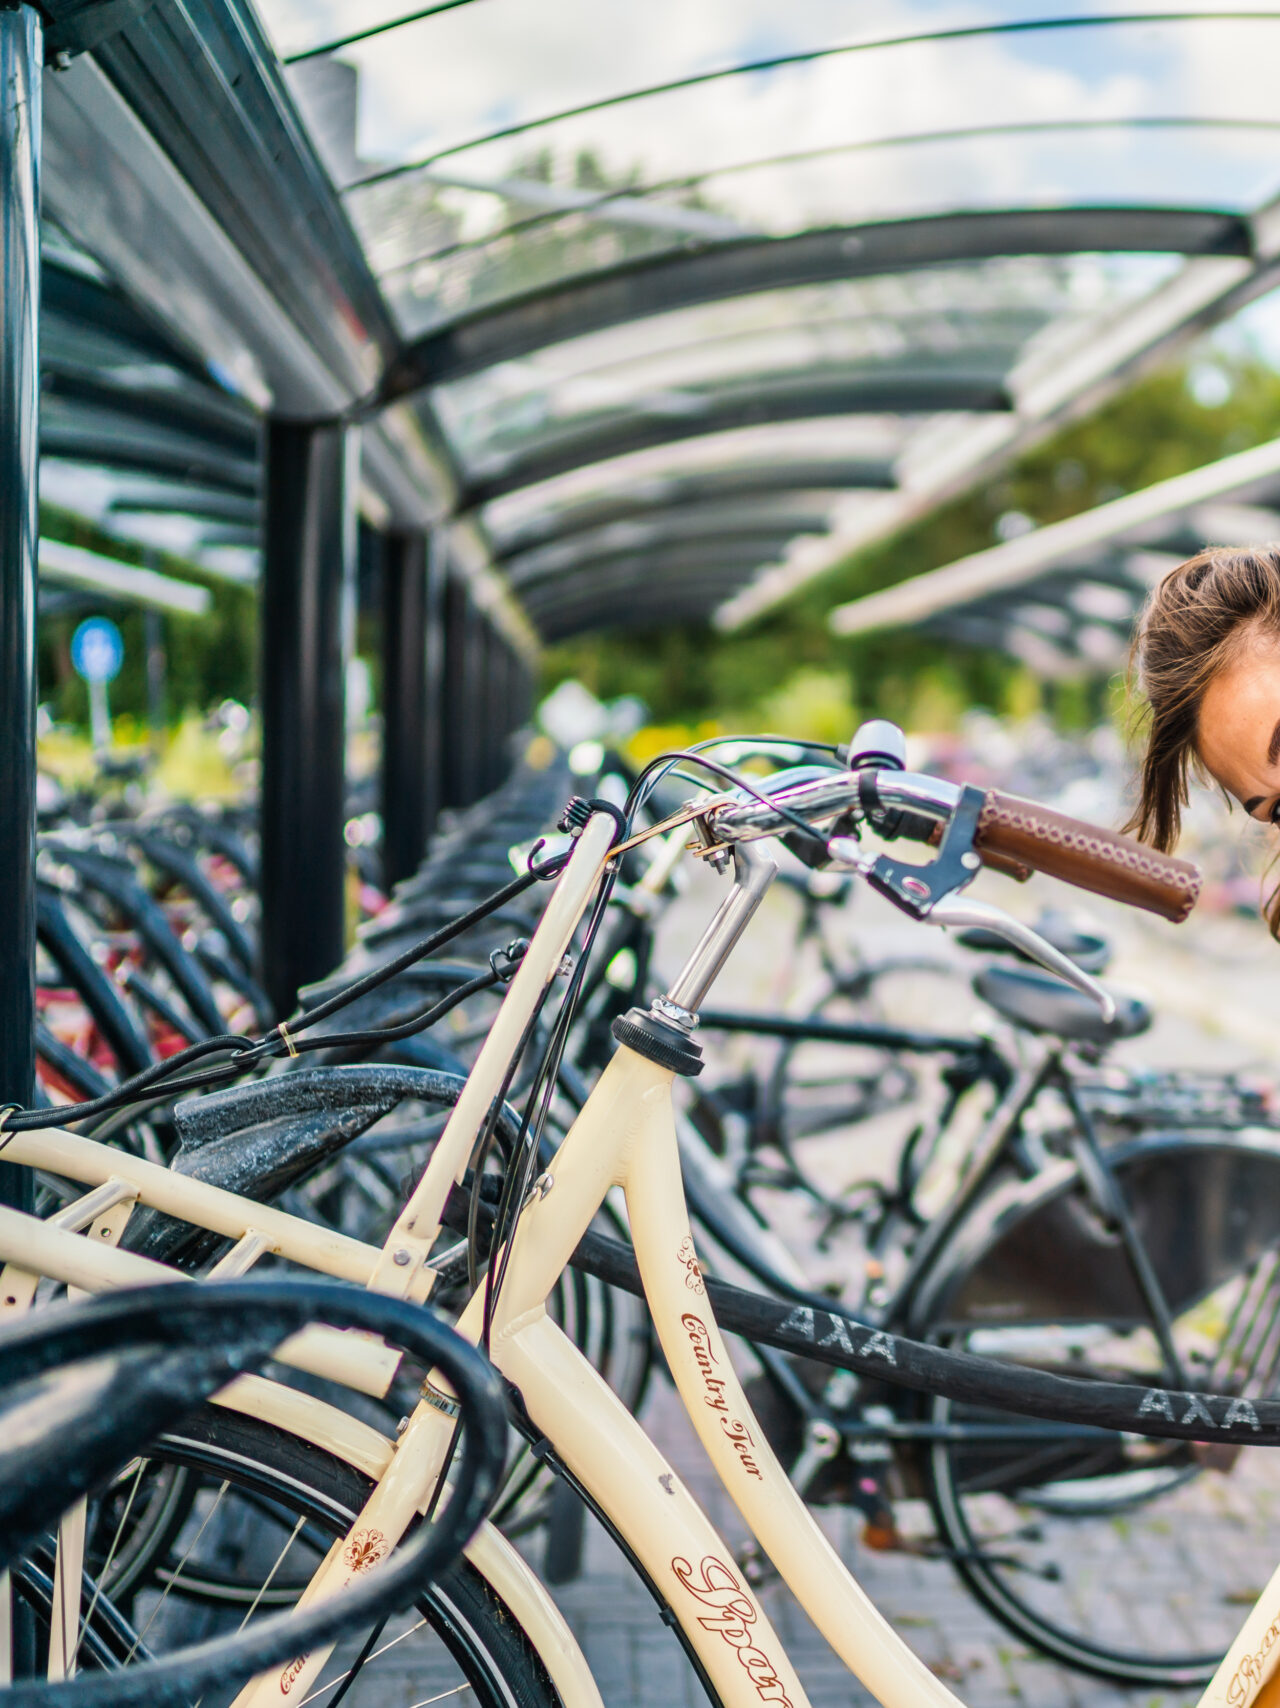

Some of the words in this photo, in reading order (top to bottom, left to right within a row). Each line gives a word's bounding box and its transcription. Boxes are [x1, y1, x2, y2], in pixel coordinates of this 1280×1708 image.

[776, 1305, 897, 1367] AXA
[681, 1312, 729, 1414] Country
[720, 1418, 763, 1481] Tour
[1135, 1388, 1261, 1431] AXA
